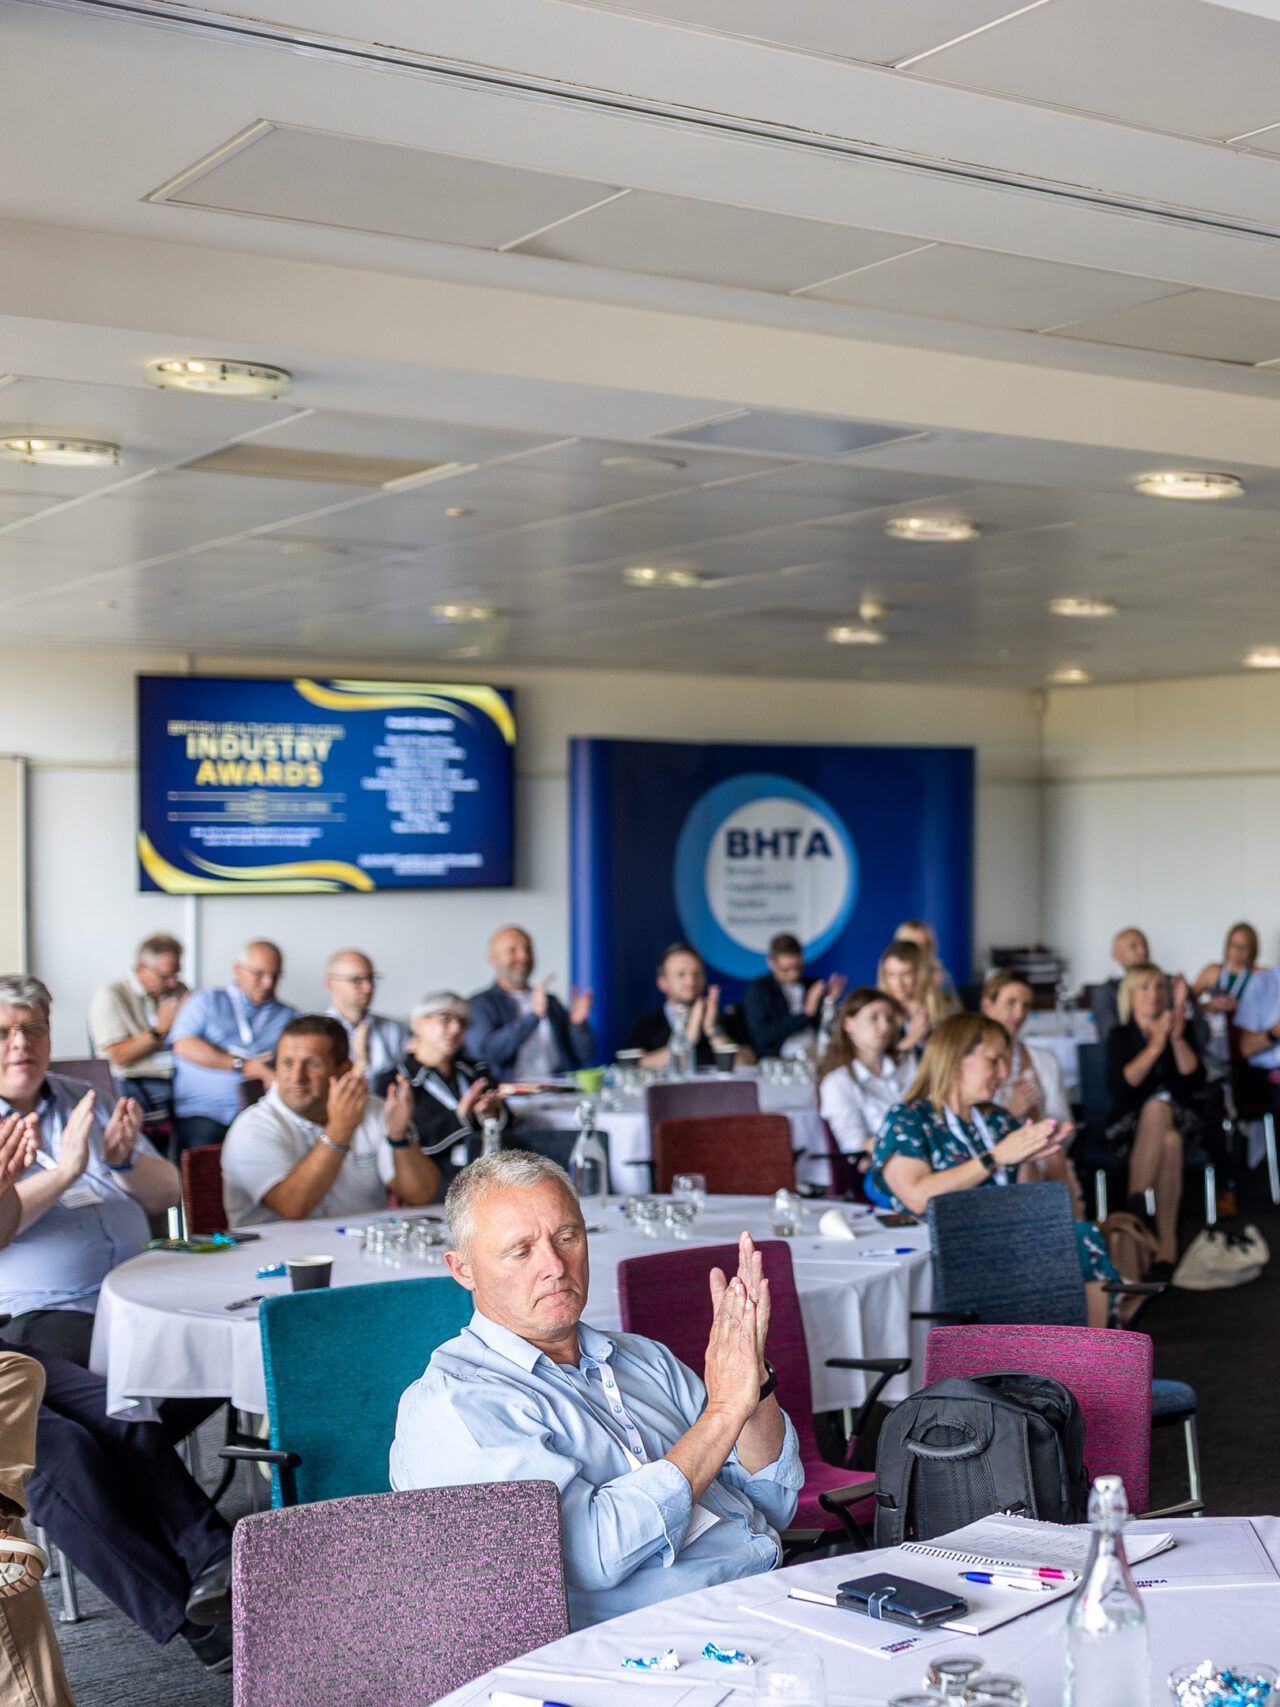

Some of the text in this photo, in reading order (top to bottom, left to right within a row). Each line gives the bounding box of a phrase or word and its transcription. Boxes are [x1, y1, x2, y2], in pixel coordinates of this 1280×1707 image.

[186, 733, 333, 761] INDUSTRY
[196, 760, 323, 787] AWARDS
[725, 828, 833, 860] BHTA
